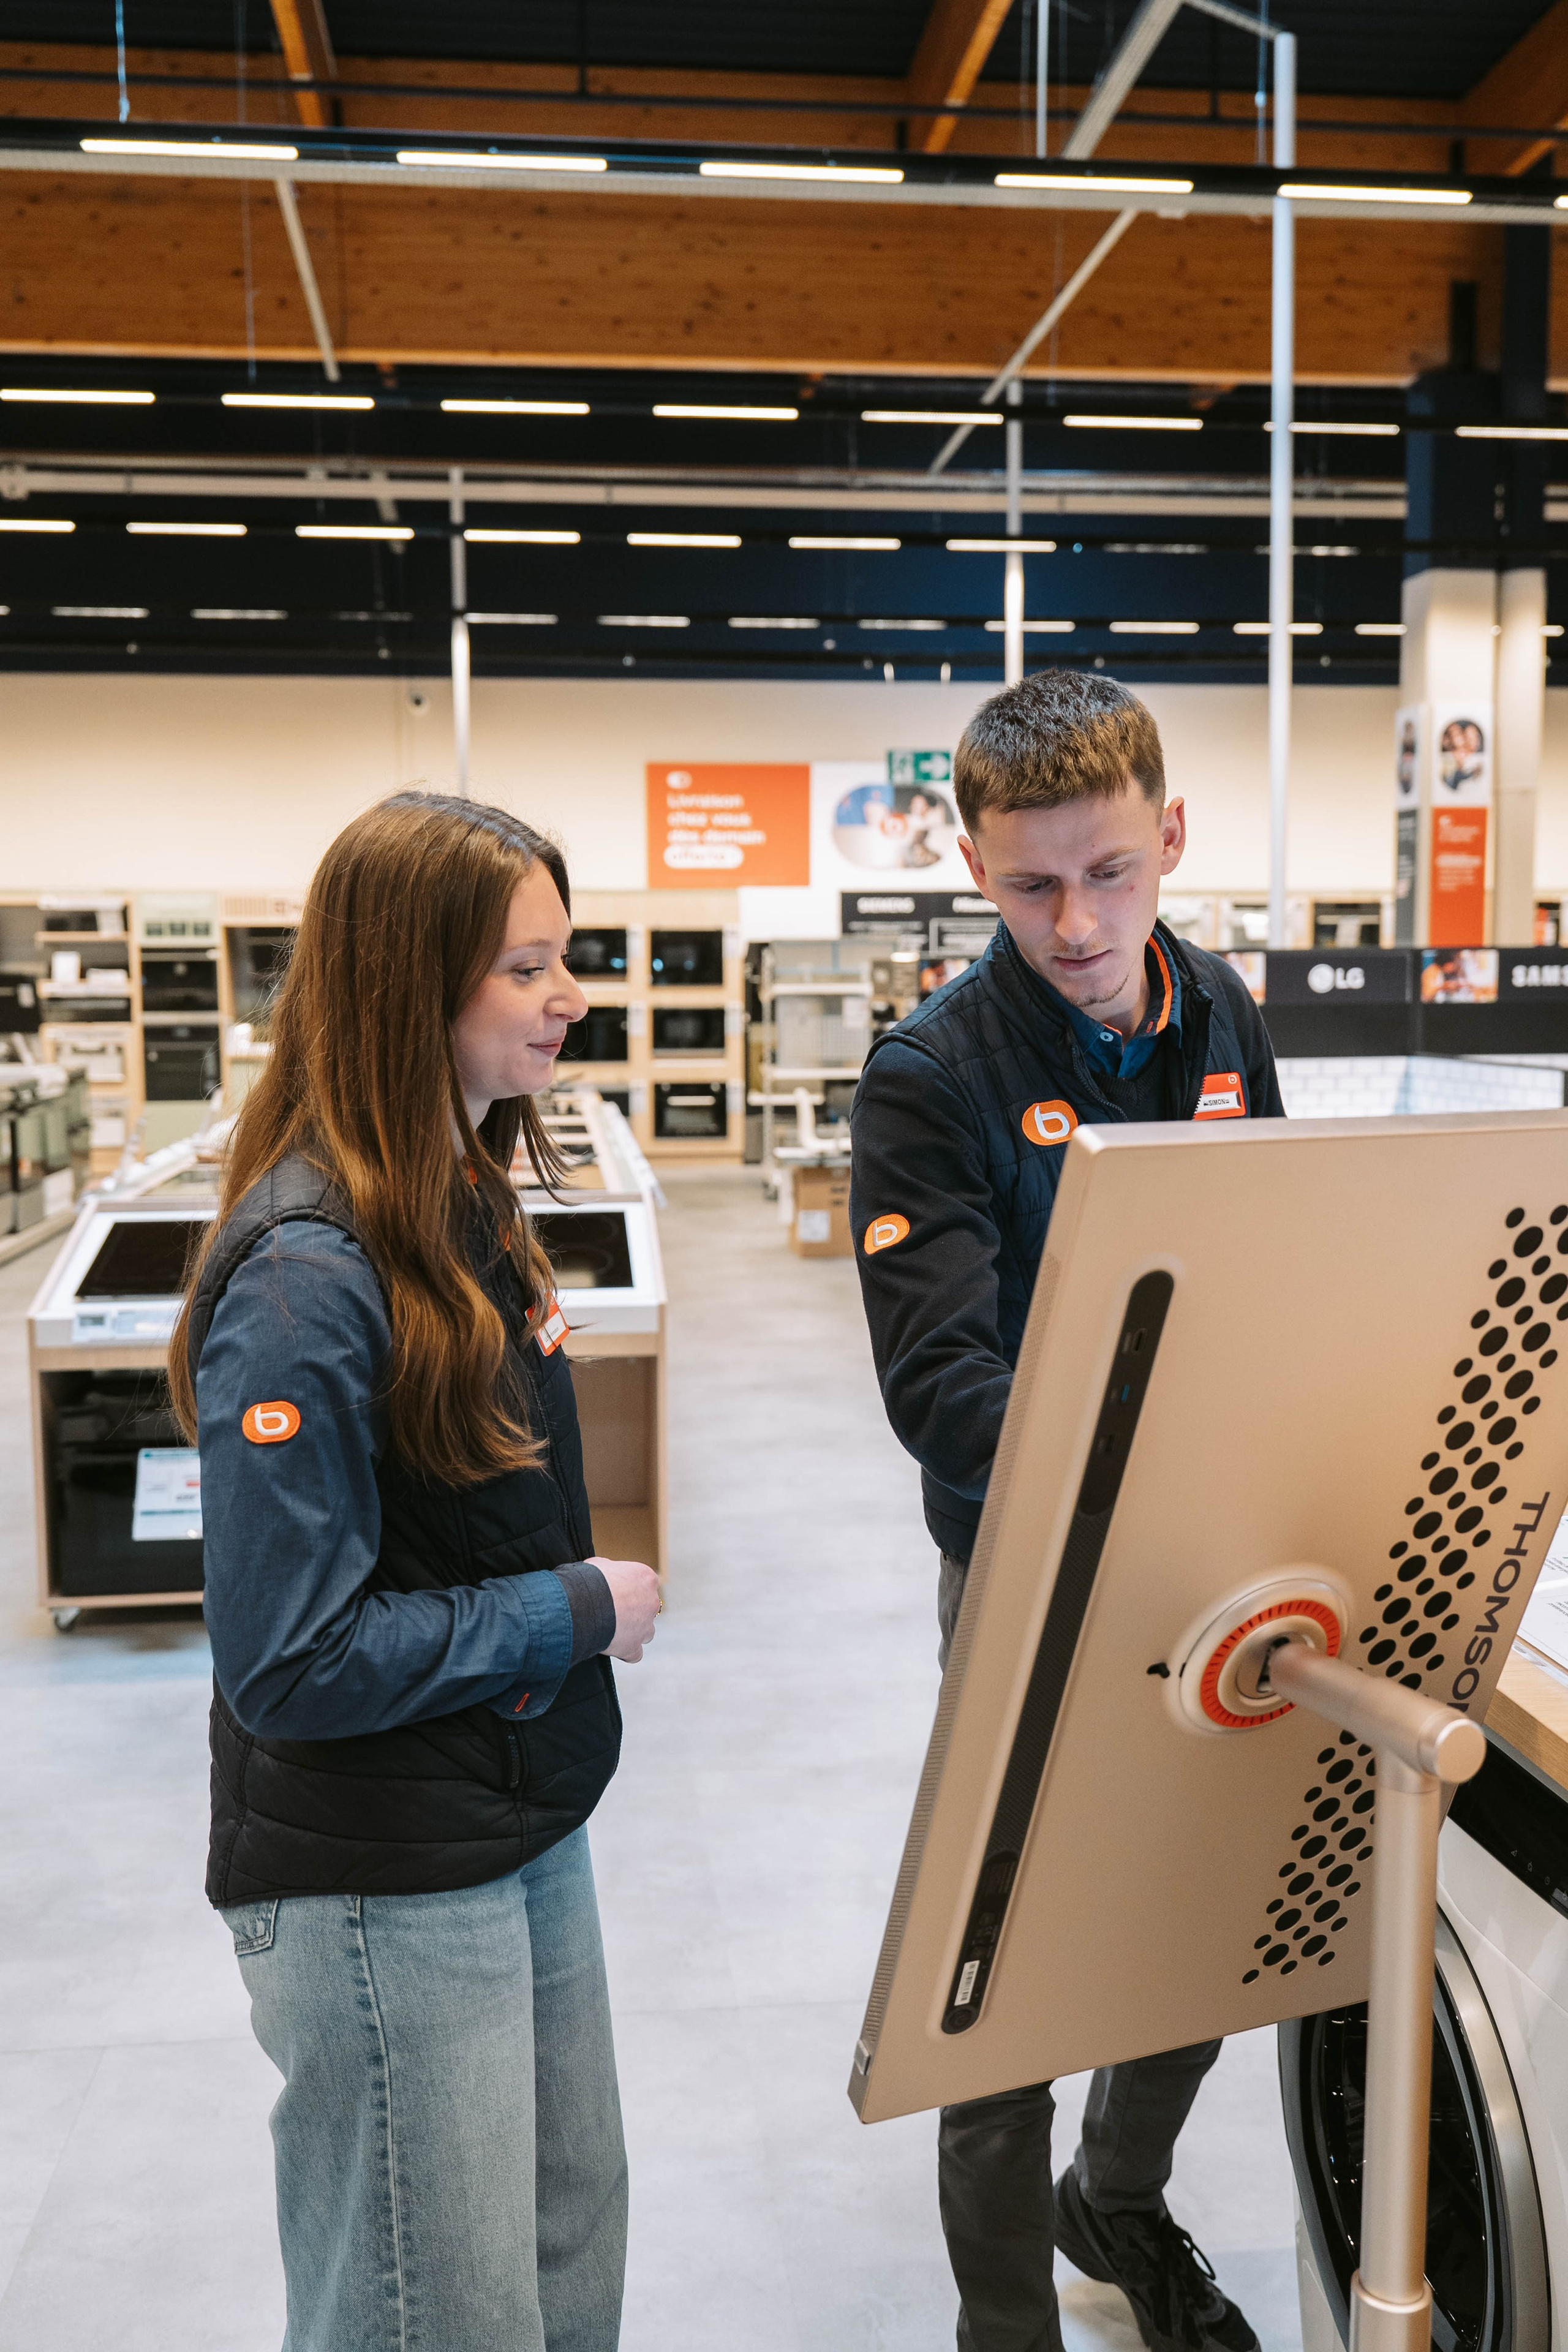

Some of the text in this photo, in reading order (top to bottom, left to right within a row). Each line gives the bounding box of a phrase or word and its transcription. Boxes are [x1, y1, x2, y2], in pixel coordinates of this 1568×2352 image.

[1335, 967, 1365, 989] LG
[1034, 1105, 1070, 1139] b
[873, 1221, 898, 1246] b
[254, 1405, 288, 1436] b
